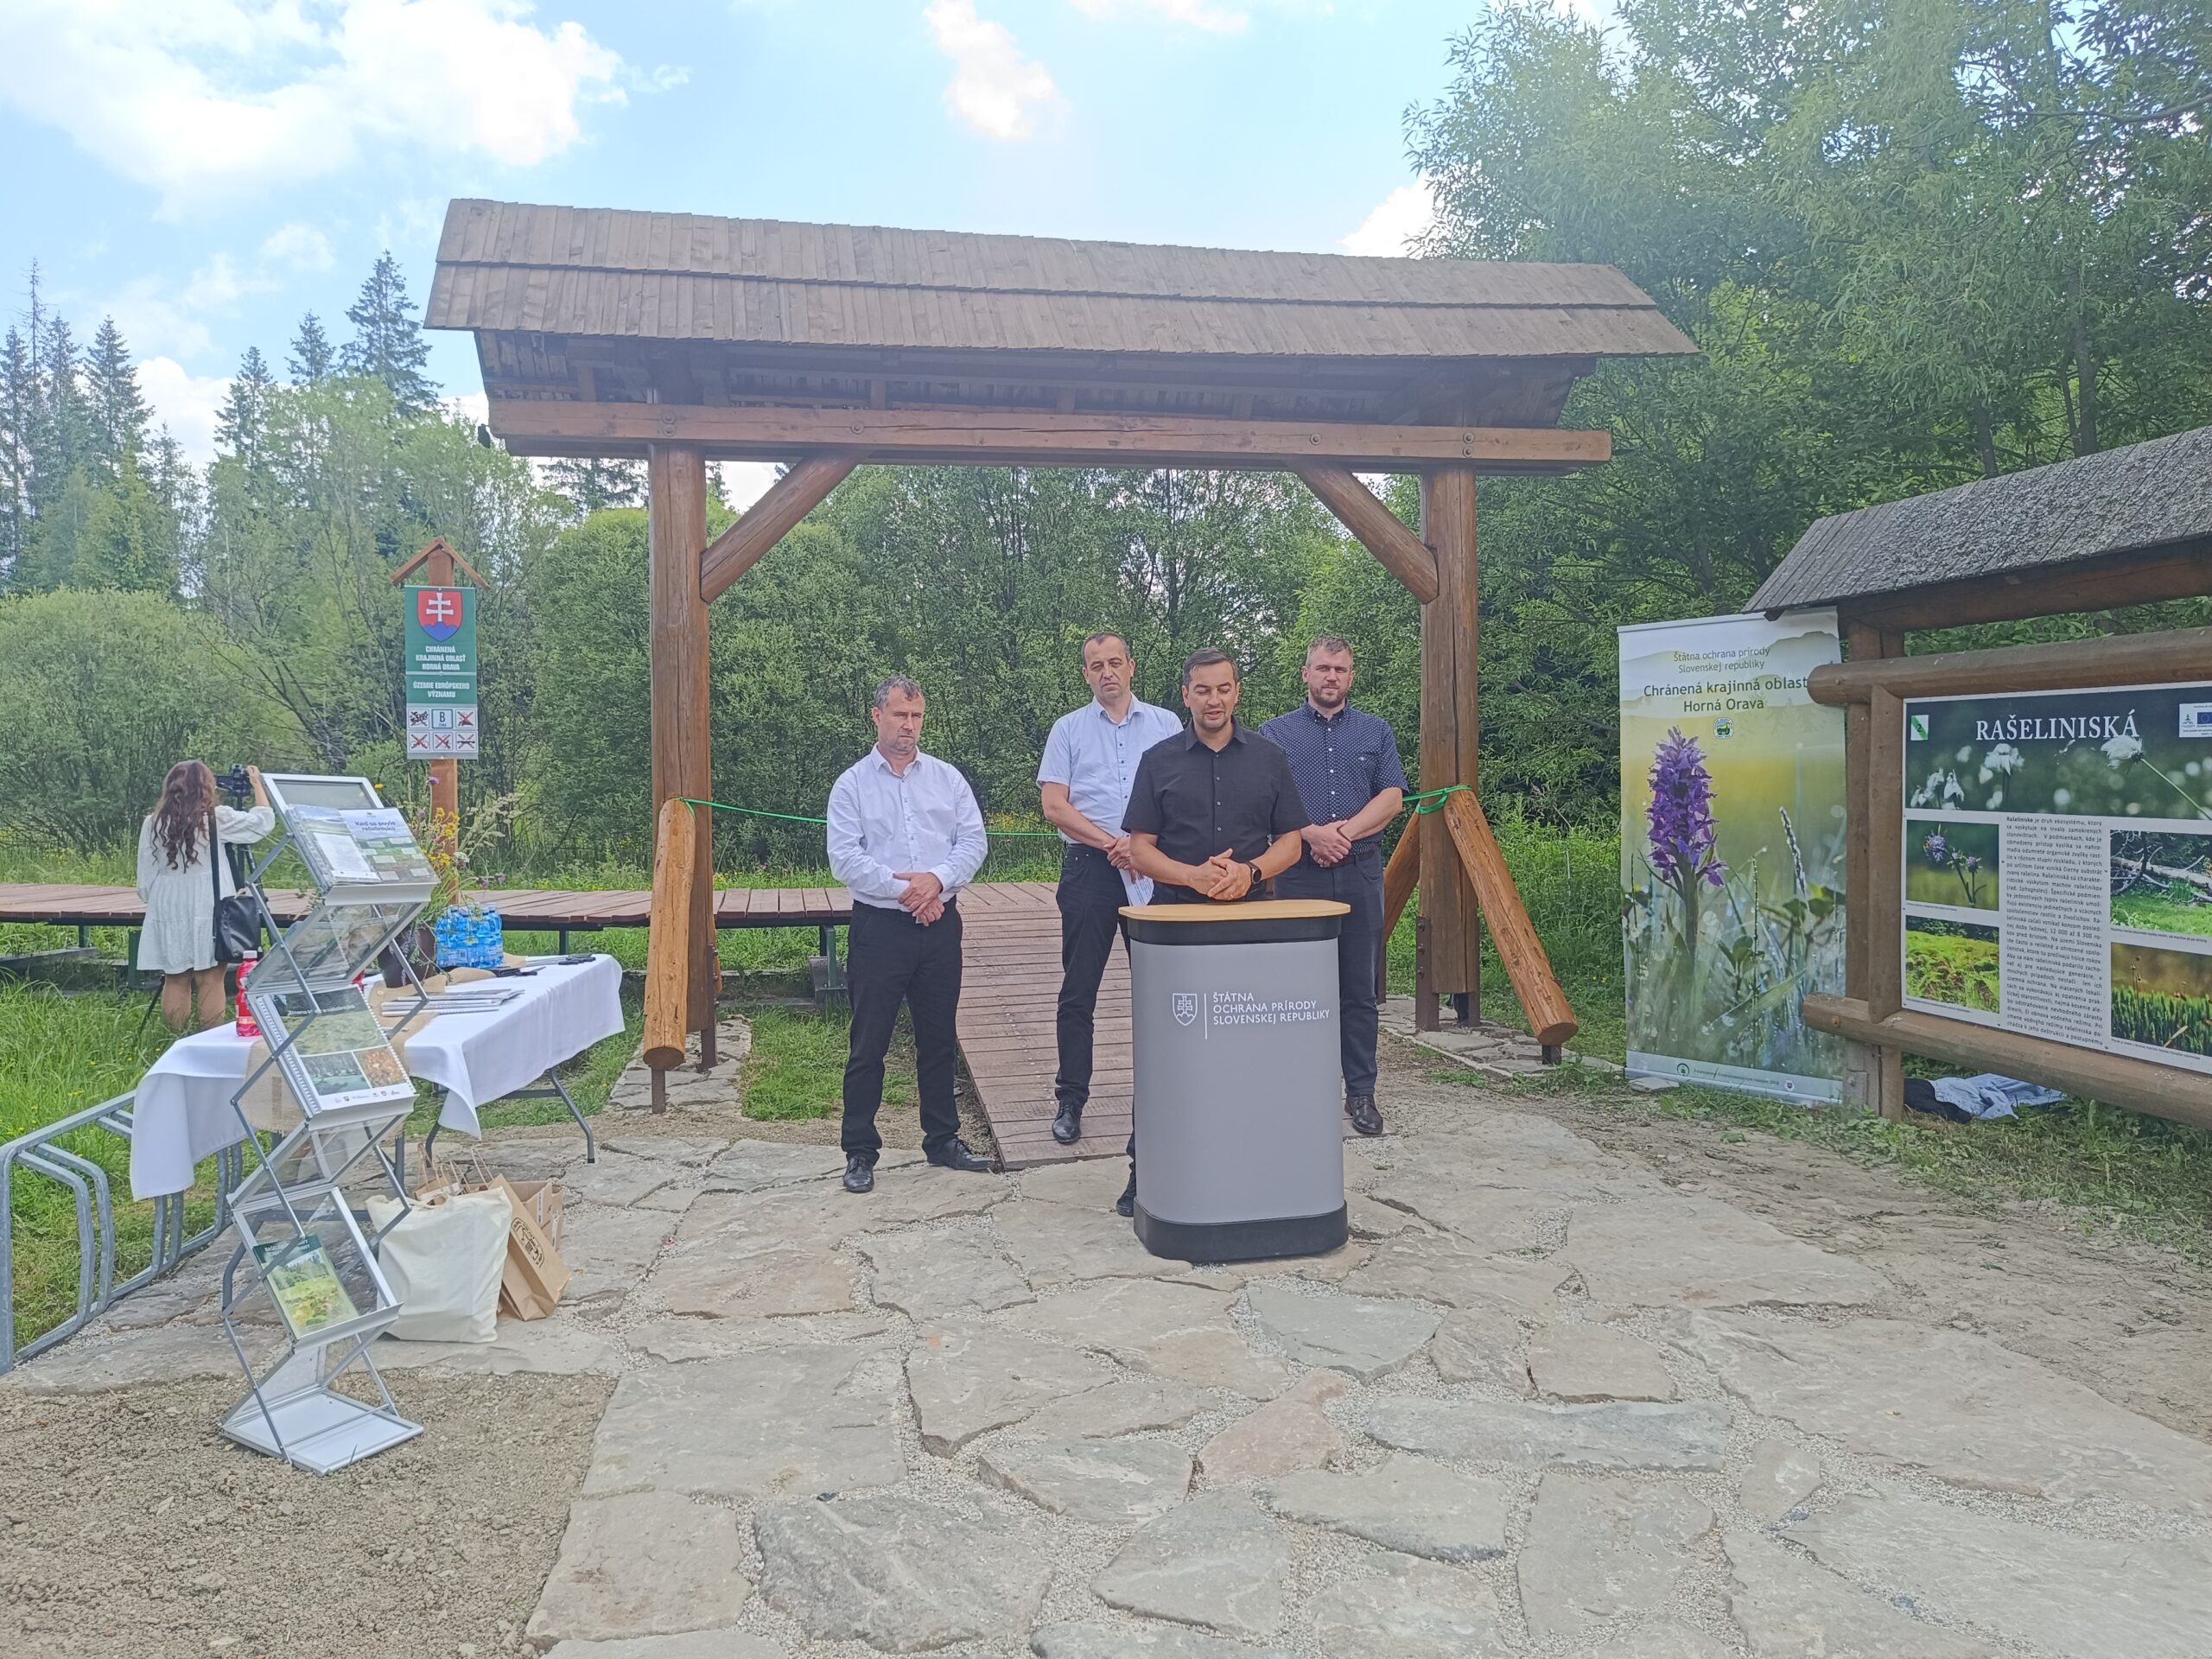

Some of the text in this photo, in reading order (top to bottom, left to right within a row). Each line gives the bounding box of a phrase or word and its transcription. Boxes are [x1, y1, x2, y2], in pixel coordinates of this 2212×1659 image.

[415, 653, 466, 662] KRAJINNÁ OBLASŤ
[1673, 645, 1770, 662] Štátna ochrana prírody
[422, 662, 442, 671] HORNÁ
[1679, 659, 1765, 674] Slovenskej republiky
[413, 680, 470, 690] ÚZEMIE EURÓPSKEHO
[1643, 682, 1702, 697] Chránená
[1707, 677, 1760, 696] krajinná
[428, 690, 456, 698] VÝZNAMU
[1683, 698, 1764, 713] Horná Orava
[439, 711, 445, 722] B
[1916, 723, 1923, 733] 2
[1975, 709, 2141, 741] RAŠELINISKÁ
[1212, 991, 1254, 1003] ŠTÁTNA
[1212, 999, 1318, 1014] OCHRANA PRÍRODY
[1212, 1008, 1331, 1026] SLOVENSKEJ REPUBLIKY
